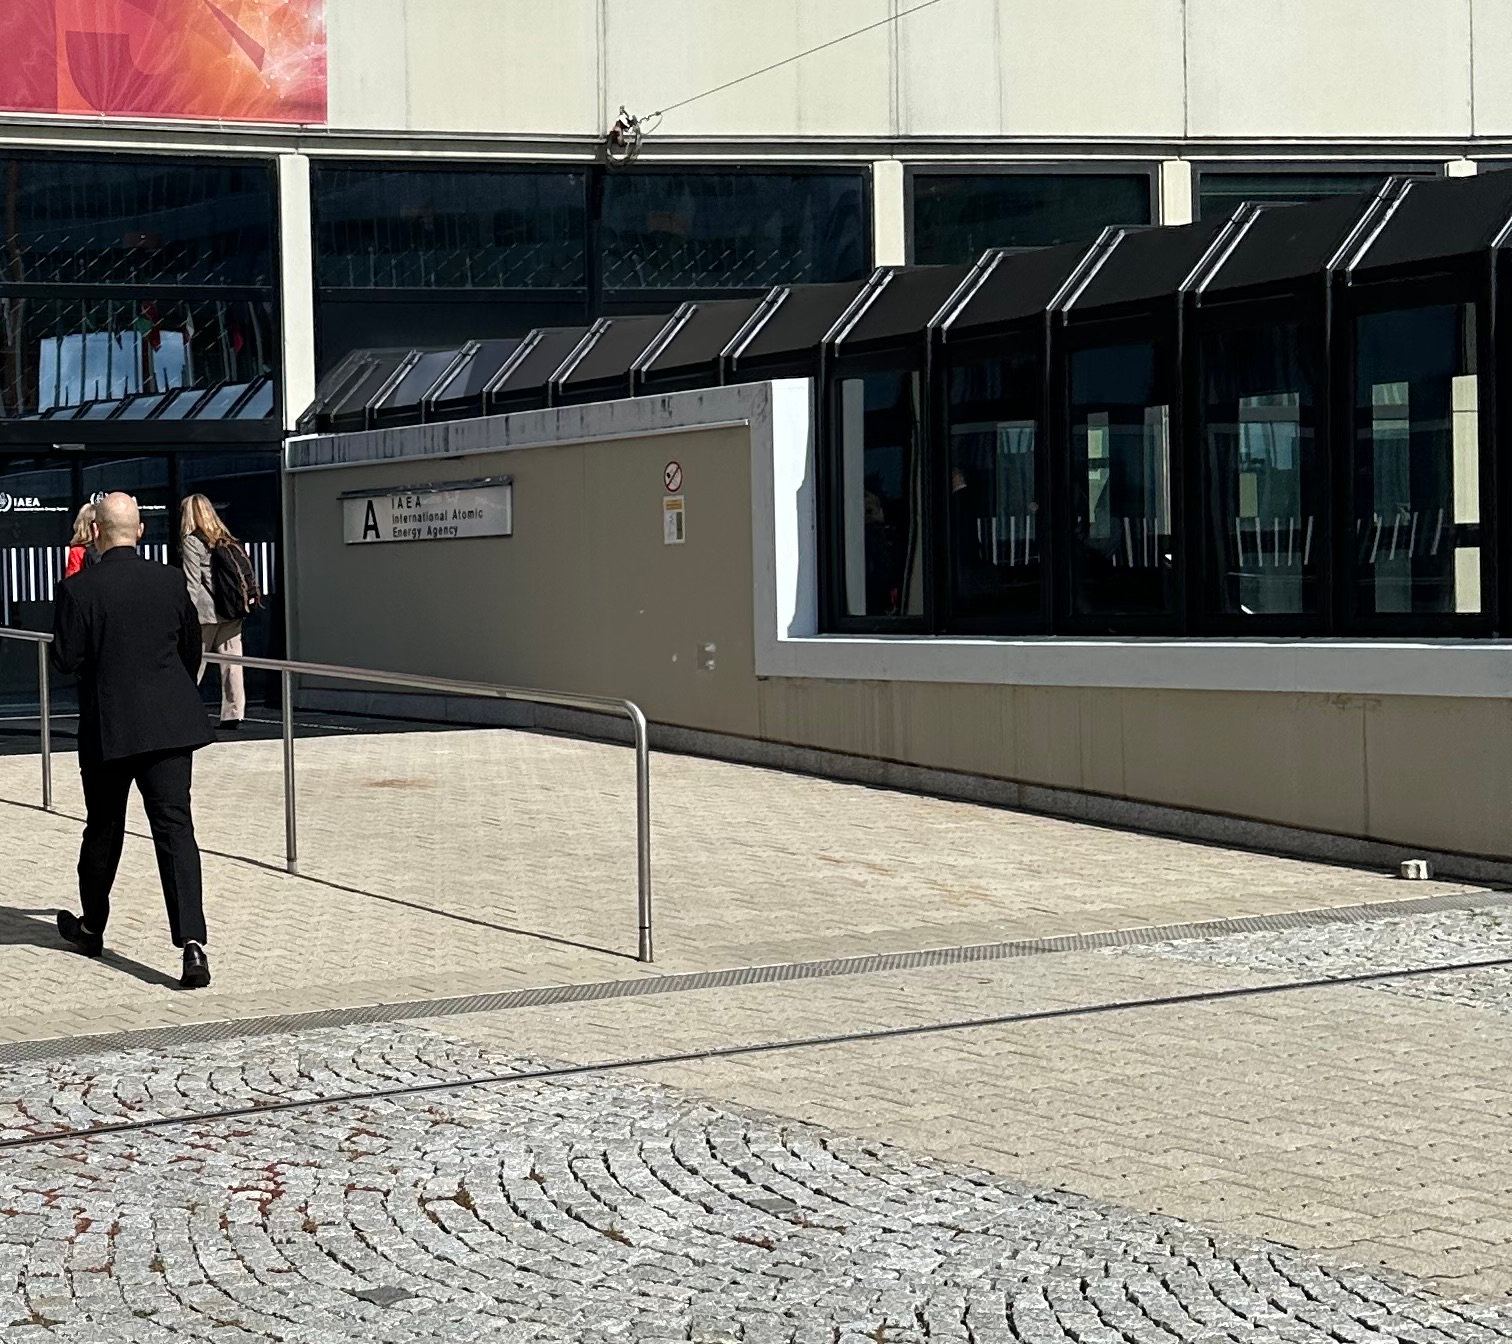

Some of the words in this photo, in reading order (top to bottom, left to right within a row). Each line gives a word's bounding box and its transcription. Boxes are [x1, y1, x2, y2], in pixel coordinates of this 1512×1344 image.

[13, 497, 41, 507] IAEA
[392, 496, 422, 510] IAEA
[363, 500, 380, 540] A
[452, 508, 484, 521] Atomic
[392, 526, 421, 539] Energy
[427, 525, 459, 537] Agency
